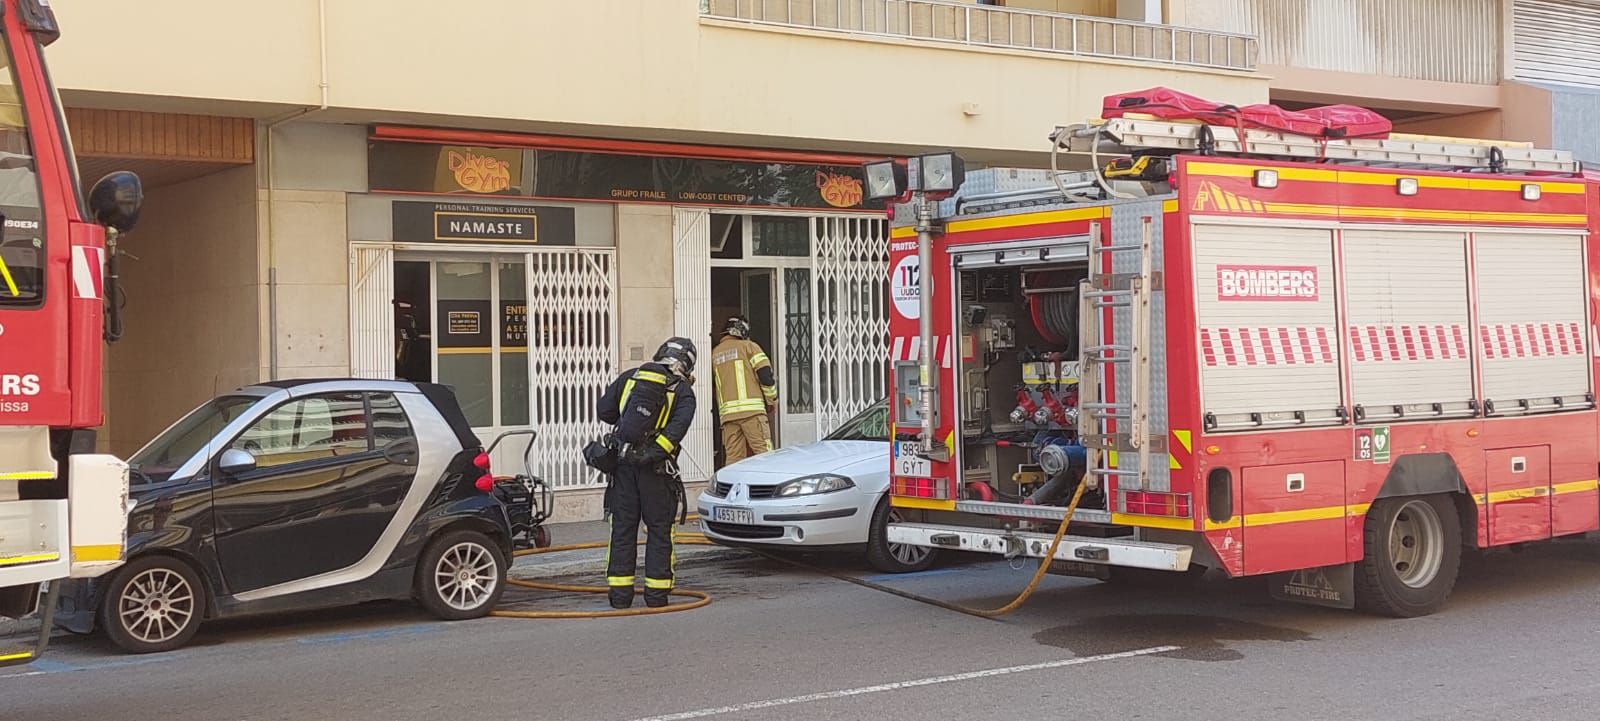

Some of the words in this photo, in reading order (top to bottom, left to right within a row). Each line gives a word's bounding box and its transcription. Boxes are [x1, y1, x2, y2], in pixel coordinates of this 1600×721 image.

[611, 190, 639, 198] GRUPO
[640, 190, 666, 199] FRAILE
[718, 194, 747, 202] CENTER
[471, 205, 504, 213] TRAINING
[450, 221, 522, 234] NAMASTE
[1220, 269, 1315, 298] BOMBERS
[1359, 435, 1371, 449] 12
[902, 460, 924, 474] GYT
